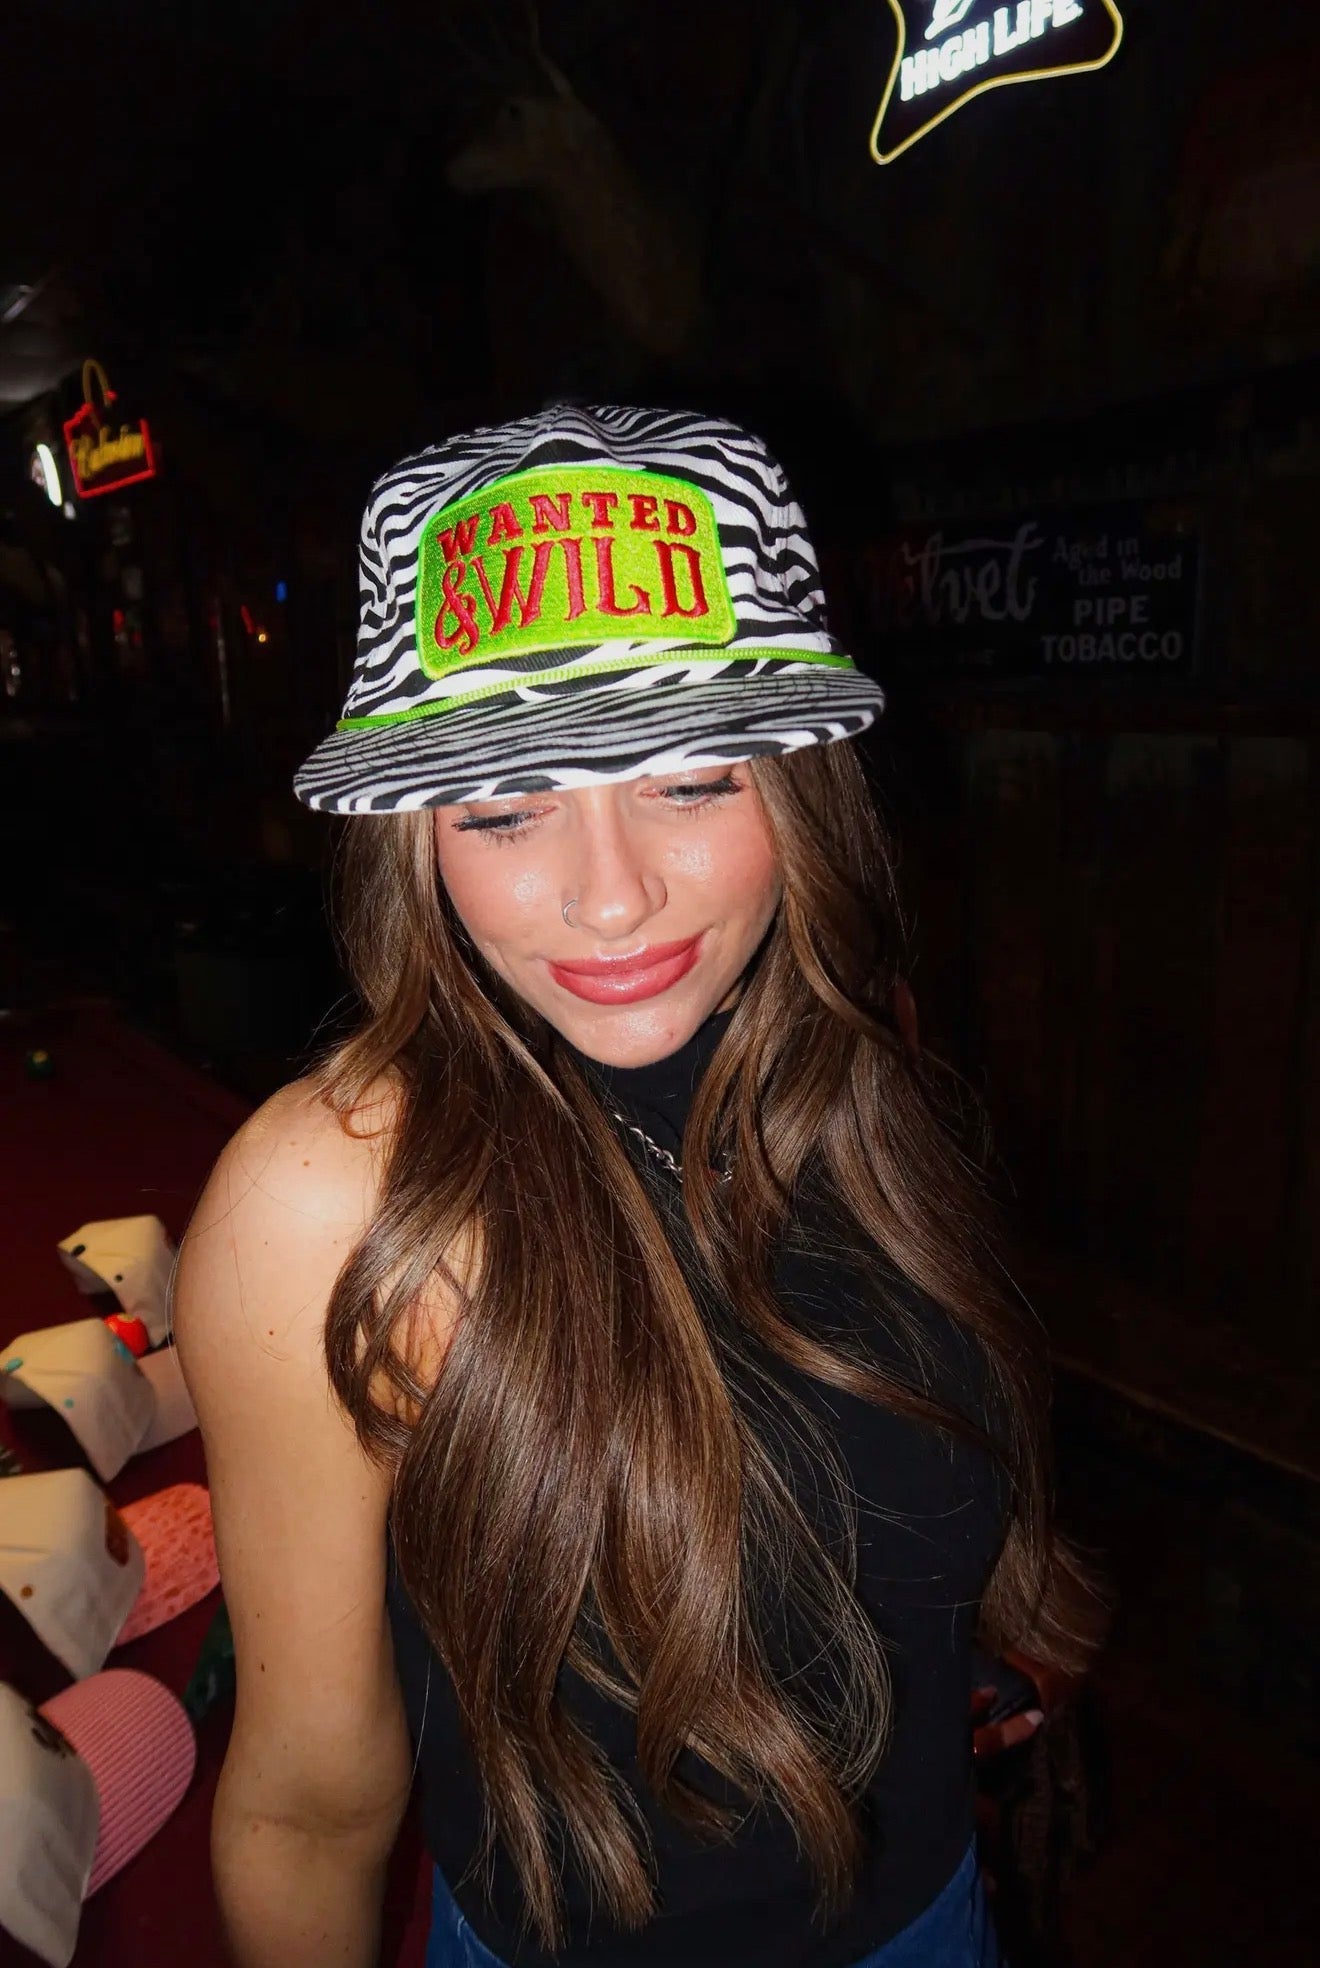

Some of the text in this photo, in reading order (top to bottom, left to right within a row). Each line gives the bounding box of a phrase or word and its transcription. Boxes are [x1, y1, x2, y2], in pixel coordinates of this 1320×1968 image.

[900, 21, 989, 101] HIGH
[994, 0, 1083, 55] LIFE
[436, 492, 697, 563] WANTED
[1120, 554, 1182, 582] Wood
[1072, 594, 1150, 627] PIPE
[1040, 630, 1184, 663] TOBACCO
